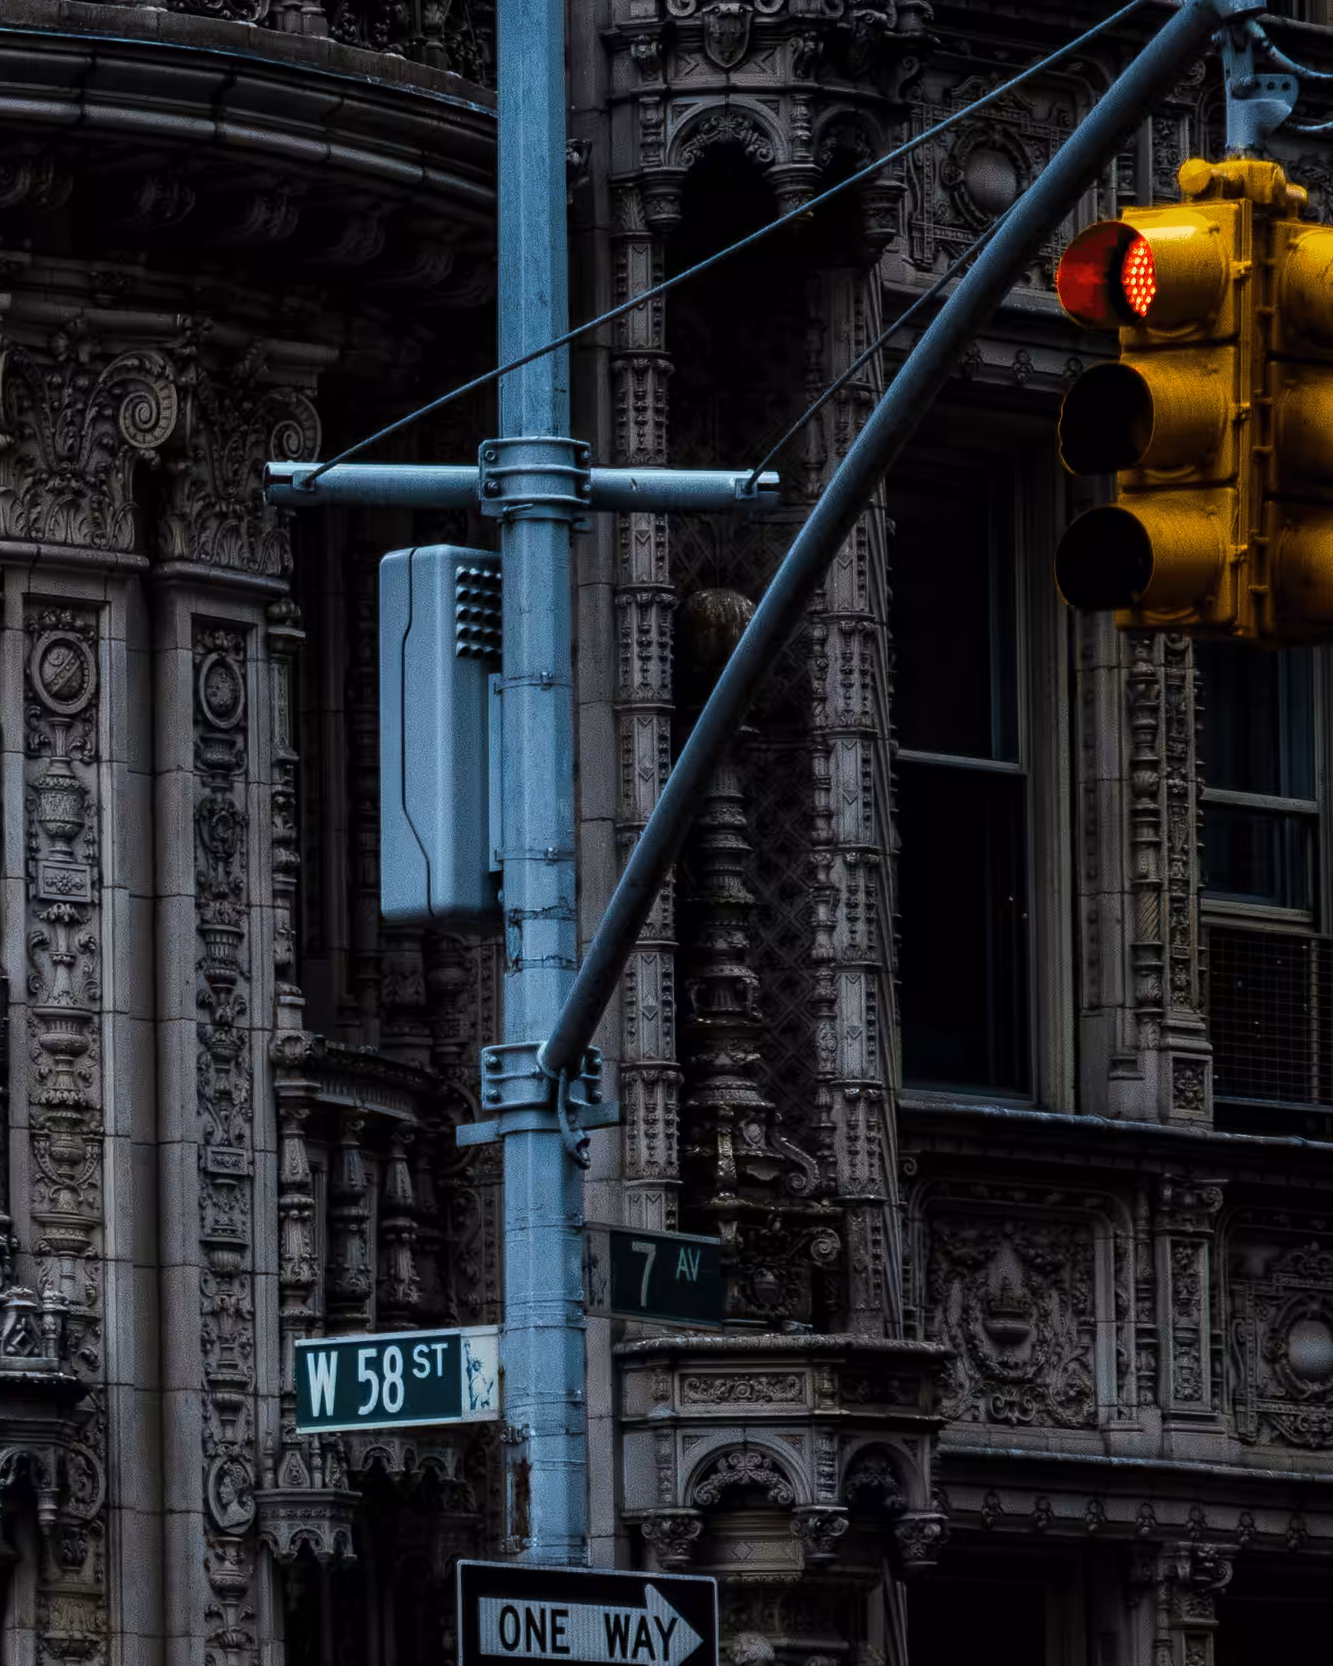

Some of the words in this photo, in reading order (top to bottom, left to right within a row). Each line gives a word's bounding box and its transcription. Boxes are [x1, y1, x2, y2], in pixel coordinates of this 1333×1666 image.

[631, 1240, 657, 1308] 7
[675, 1245, 701, 1283] AV
[306, 1350, 339, 1418] W
[357, 1345, 405, 1416] 58
[412, 1343, 449, 1379] ST
[499, 1604, 571, 1655] ONE
[604, 1611, 678, 1662] WAY
